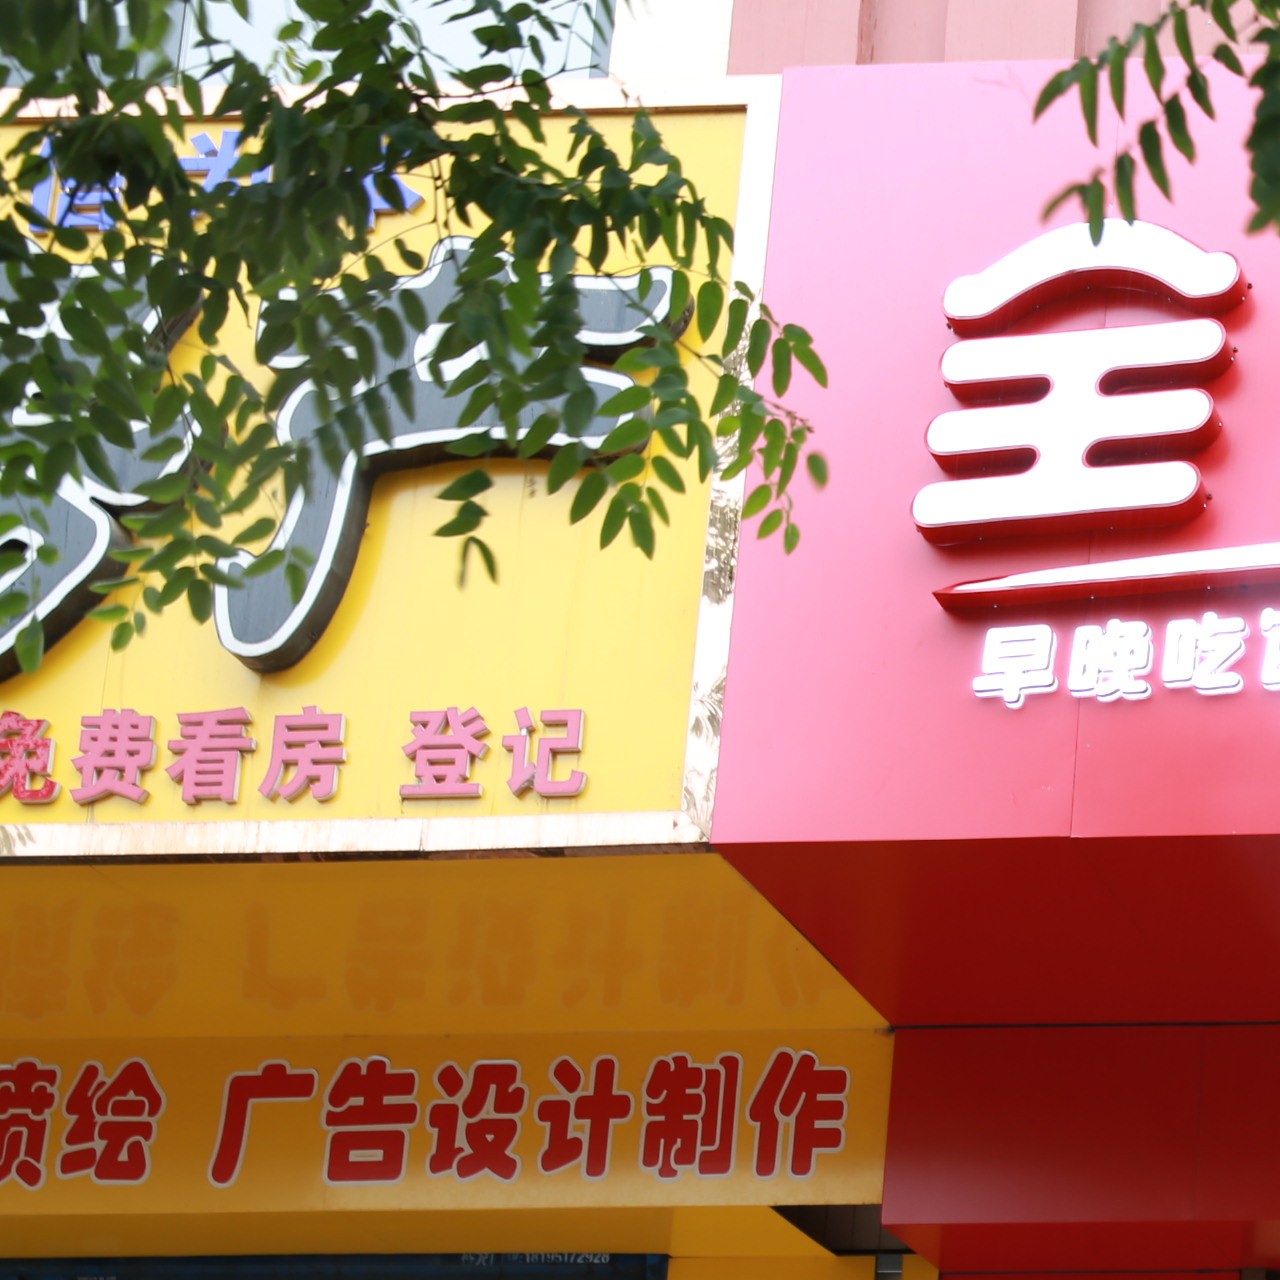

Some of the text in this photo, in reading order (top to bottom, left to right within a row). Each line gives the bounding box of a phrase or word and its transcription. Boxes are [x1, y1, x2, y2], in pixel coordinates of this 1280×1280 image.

[0, 705, 587, 806] 免费看房 登记
[208, 1045, 850, 1188] 广告设计制作
